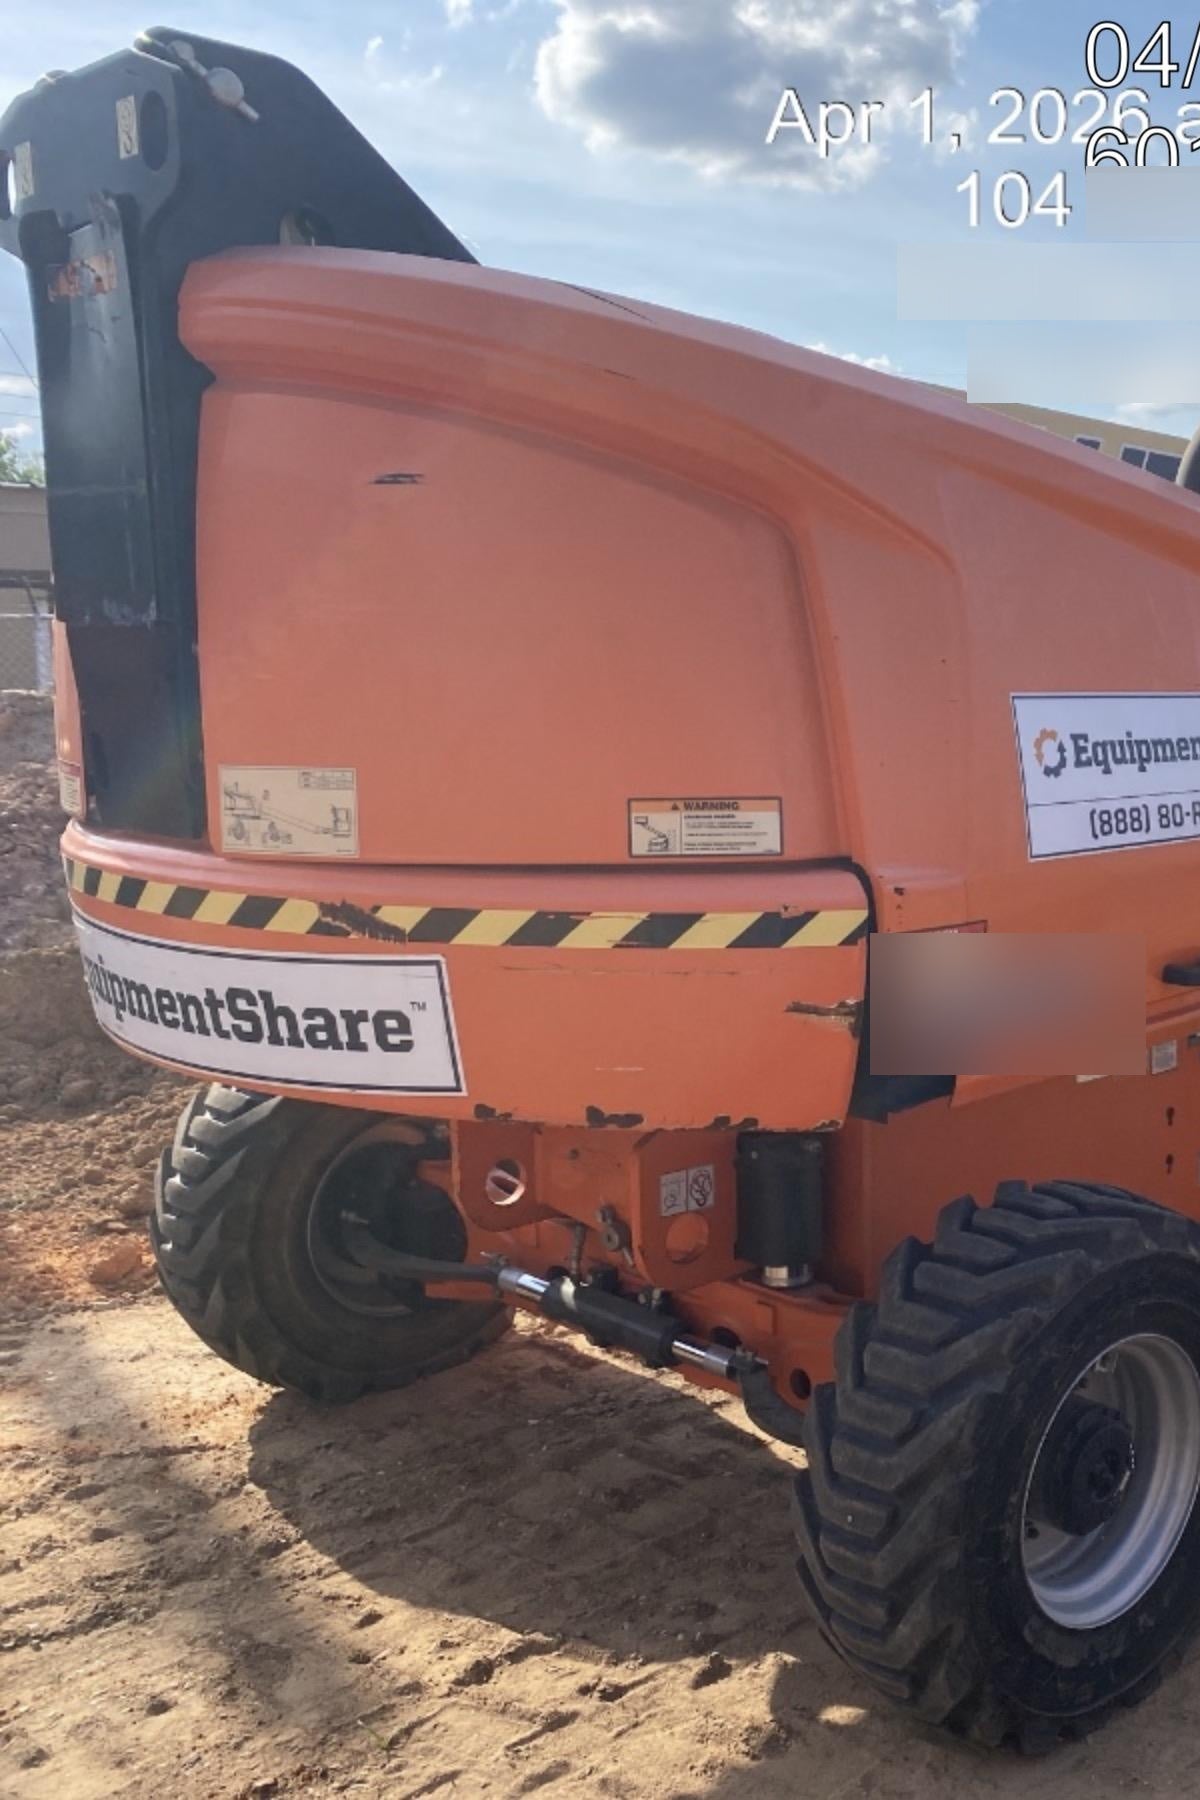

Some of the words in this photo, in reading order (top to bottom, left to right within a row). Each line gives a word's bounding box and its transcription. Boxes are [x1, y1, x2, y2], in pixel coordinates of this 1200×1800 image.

[684, 801, 740, 811] WARNING
[1089, 804, 1151, 840] (888)
[85, 953, 415, 1053] quipmentShare
